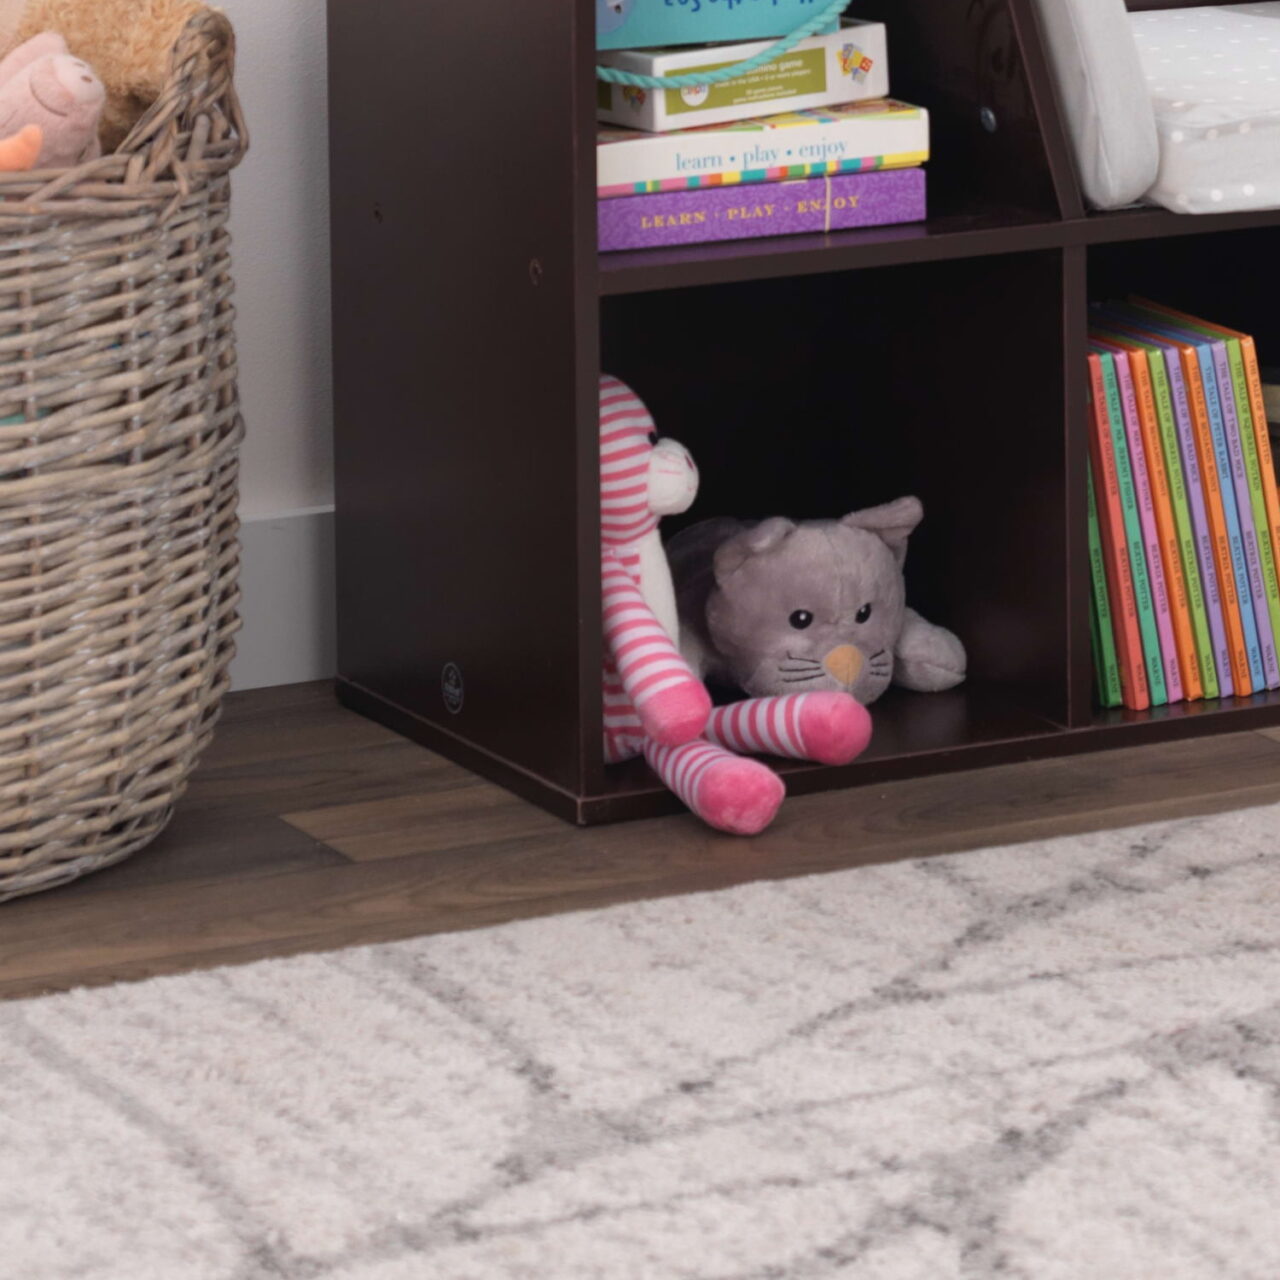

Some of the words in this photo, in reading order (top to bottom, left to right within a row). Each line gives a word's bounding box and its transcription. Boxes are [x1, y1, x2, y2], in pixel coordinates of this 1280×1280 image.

[675, 153, 723, 171] learn
[742, 144, 779, 170] play
[798, 136, 847, 161] enjoy
[640, 210, 706, 229] LEARN
[727, 204, 776, 220] PLAY
[1172, 366, 1181, 382] THE
[1191, 366, 1199, 381] THE
[1205, 366, 1213, 383] THE
[1219, 361, 1227, 378] THE
[1235, 361, 1243, 378] THE
[1249, 359, 1257, 374] THE
[1106, 372, 1114, 389] THE
[1123, 374, 1131, 390] THE
[1140, 370, 1148, 386] THE
[1156, 370, 1164, 387] THE
[1252, 378, 1260, 397] TALE
[1159, 389, 1168, 409] TALE
[1176, 386, 1185, 405] TALE
[1194, 385, 1203, 404] TALE
[1208, 385, 1216, 404] TALE
[1222, 381, 1231, 401] TALE
[1238, 381, 1247, 400] TALE
[1109, 391, 1118, 411] TALE
[1126, 393, 1135, 412] TALE
[1225, 403, 1232, 413] OF
[1242, 403, 1248, 413] OF
[1255, 400, 1262, 411] OF
[1113, 414, 1120, 424] OF
[1130, 415, 1137, 425] OF
[1163, 412, 1170, 422] OF
[1180, 408, 1187, 417] OF
[1198, 407, 1205, 417] OF
[1211, 407, 1219, 418] OF
[1182, 422, 1191, 440] TWO
[1214, 422, 1223, 447] PETER
[1228, 417, 1236, 437] TWO
[1186, 443, 1194, 460] BAD
[1231, 439, 1239, 456] BAD
[1260, 433, 1270, 464] KITTEN
[1189, 463, 1198, 482] MICE
[1218, 450, 1228, 478] RABBIT
[1234, 458, 1243, 478] MICE
[1168, 539, 1180, 573] BEATRIX
[1175, 576, 1186, 607] POTTER
[1202, 535, 1213, 569] BEATRIX
[1208, 572, 1218, 603] POTTER
[1218, 535, 1229, 569] BEATRIX
[1224, 573, 1234, 604] POTTER
[1232, 536, 1243, 570] BEATRIX
[1238, 573, 1248, 604] POTTER
[1246, 530, 1257, 564] BEATRIX
[1252, 568, 1262, 598] POTTER
[1261, 530, 1272, 564] BEATRIX
[1267, 567, 1277, 598] POTTER
[1133, 541, 1144, 576] BEATRIX
[1139, 579, 1149, 610] POTTER
[1151, 544, 1162, 578] BEATRIX
[1157, 581, 1167, 613] POTTER
[1184, 540, 1196, 575] BEATRIX
[1191, 577, 1202, 608] POTTER
[1098, 586, 1107, 617] POTTER
[1124, 585, 1134, 617] POTTER
[1188, 653, 1198, 682] WARNE
[1220, 649, 1230, 677] WARNE
[1236, 649, 1246, 678] WARNE
[1250, 646, 1260, 675] WARNE
[1264, 643, 1275, 673] WARNE
[1151, 656, 1161, 686] WARNE
[1169, 657, 1179, 686] WARNE
[1204, 654, 1214, 682] WARNE
